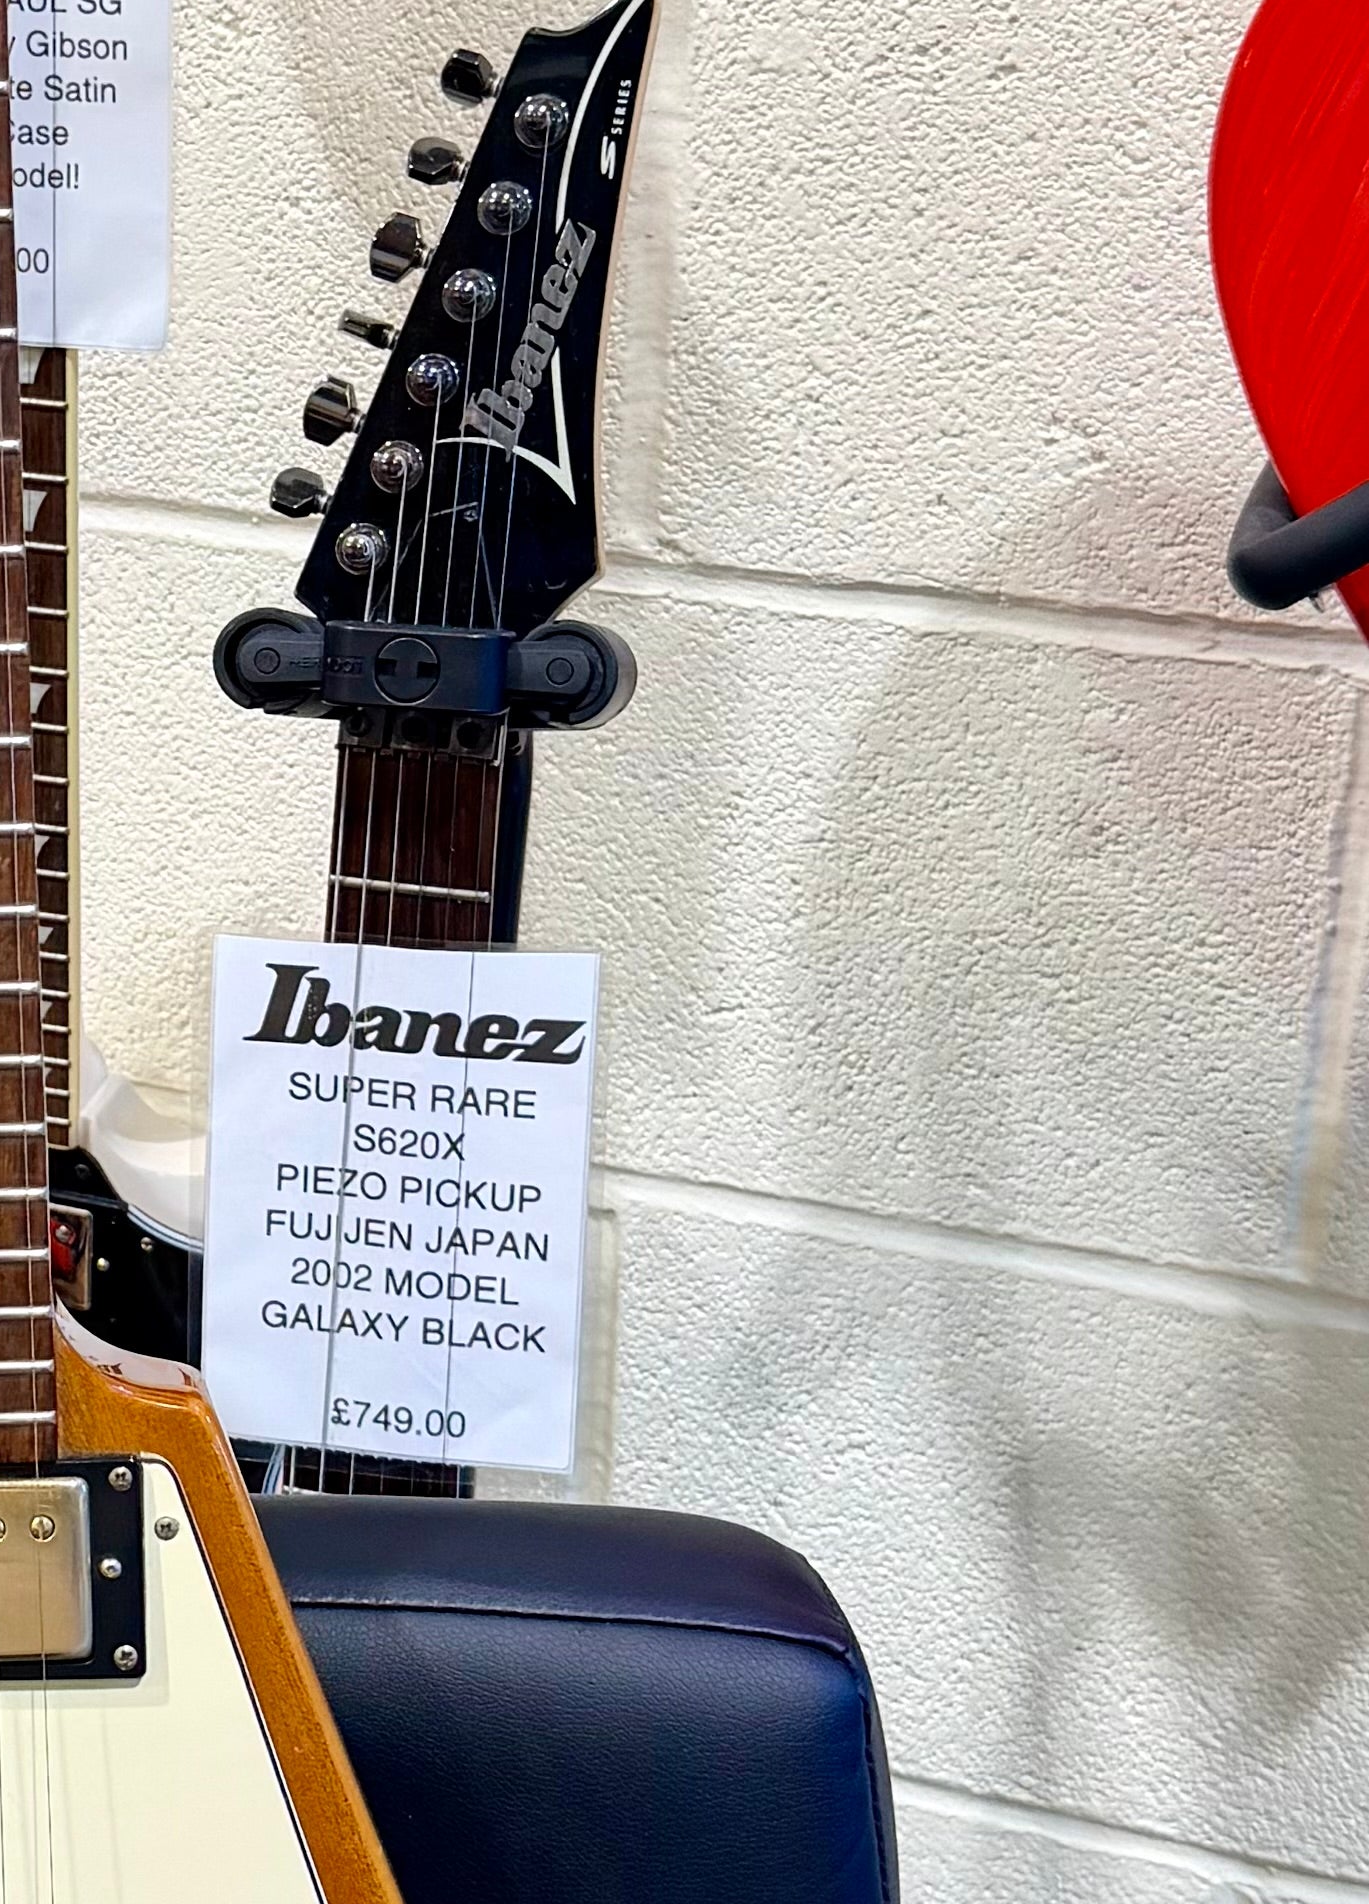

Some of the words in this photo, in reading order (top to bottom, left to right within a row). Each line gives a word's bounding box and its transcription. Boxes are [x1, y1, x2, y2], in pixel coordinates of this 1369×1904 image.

[25, 30, 128, 62] Gibson
[43, 74, 117, 104] Satin
[610, 79, 633, 135] SERIES
[12, 162, 80, 189] odel!
[459, 218, 597, 463] Ibanez
[241, 962, 588, 1065] Ibanez
[288, 1071, 416, 1111] SUPER
[430, 1084, 537, 1119] RARE
[352, 1123, 466, 1162] S620X
[277, 1163, 387, 1201] PIEZO
[399, 1175, 542, 1213] PICKUP
[425, 1225, 549, 1262] JAPAN
[290, 1257, 373, 1293] 2002
[384, 1267, 520, 1306] MODEL
[261, 1300, 410, 1342] GALAXY
[421, 1316, 546, 1353] BLACK
[330, 1397, 466, 1438] £749.00
